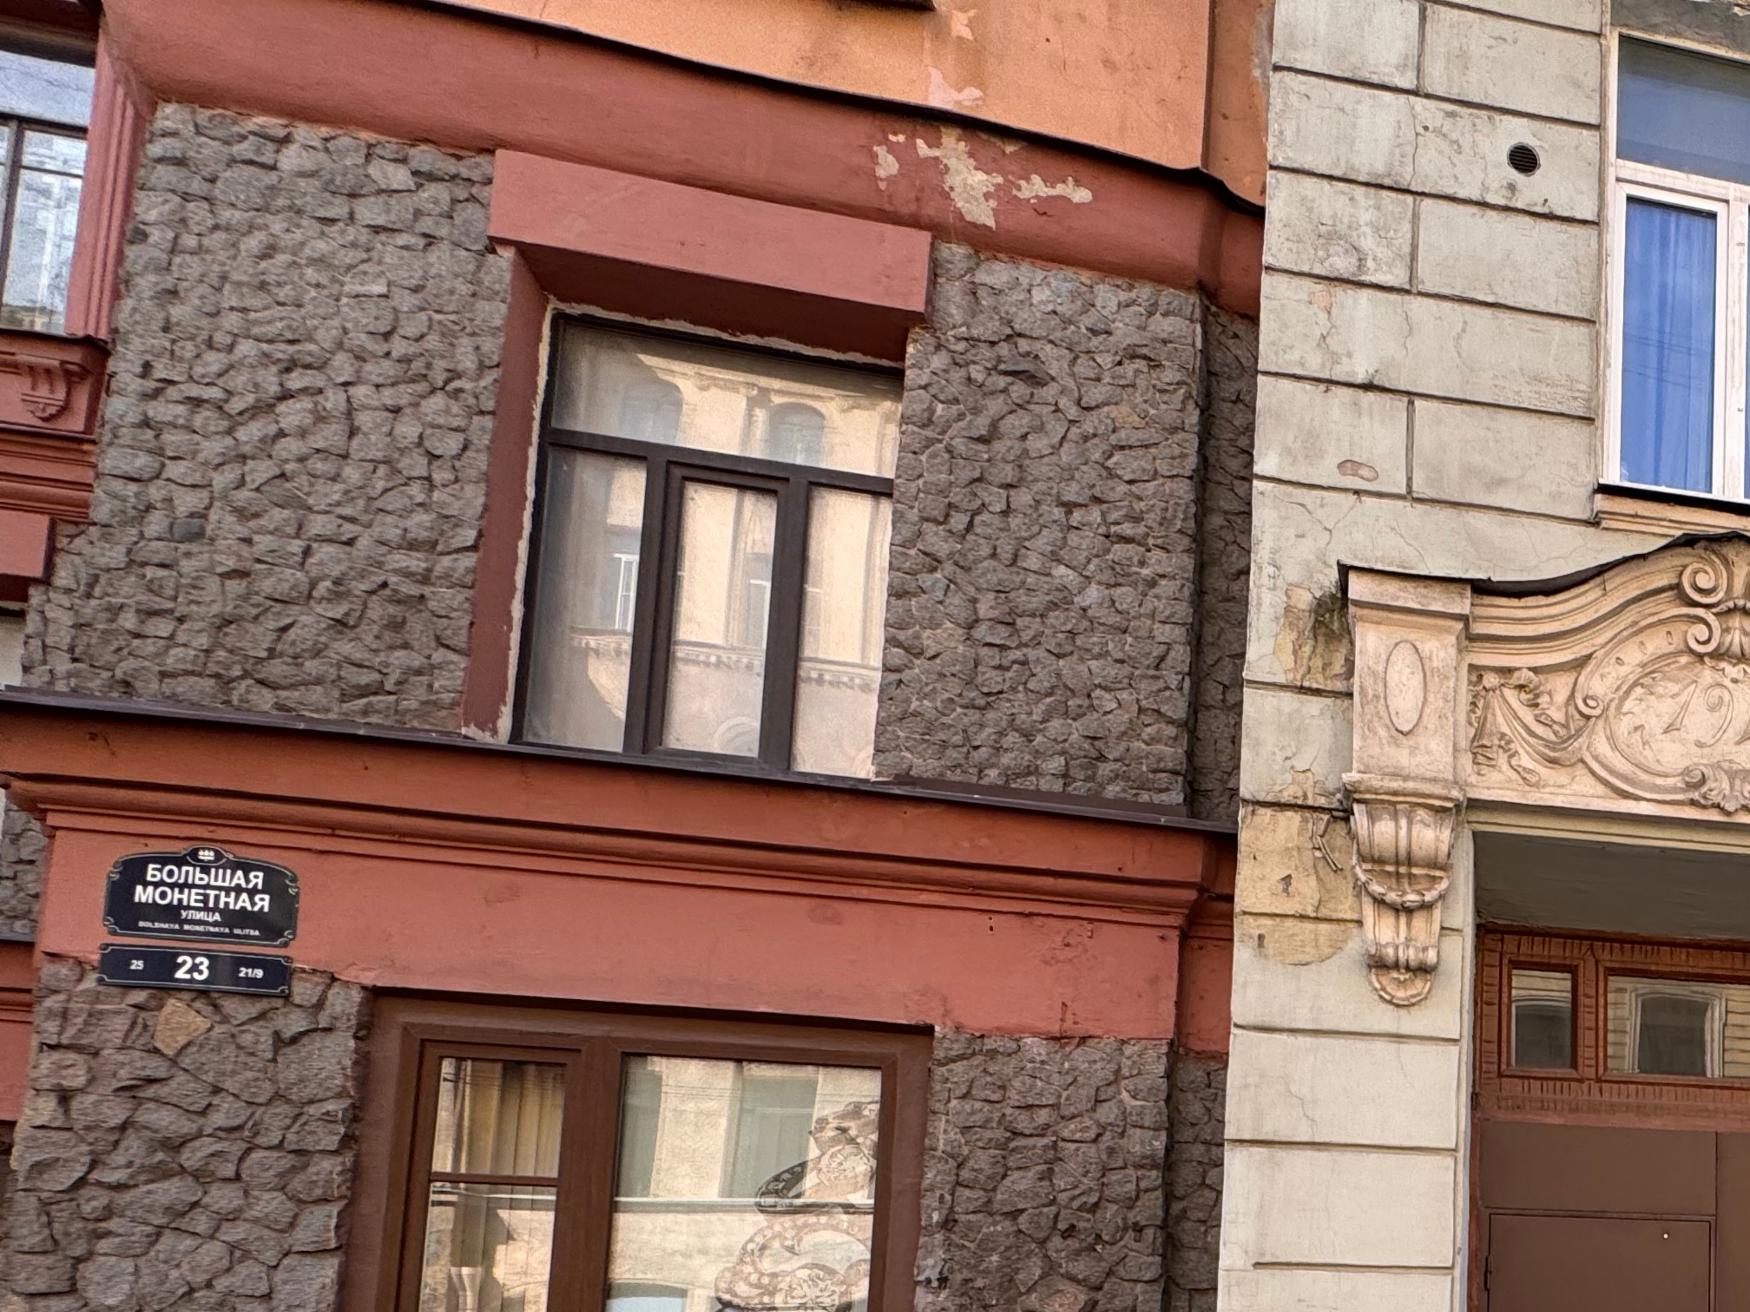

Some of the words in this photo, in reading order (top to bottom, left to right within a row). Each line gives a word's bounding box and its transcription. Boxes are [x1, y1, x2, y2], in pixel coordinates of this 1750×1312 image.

[146, 864, 264, 890] БОЛЬШАЯ
[134, 885, 271, 913] МОНЕТНАЯ
[180, 909, 222, 923] УЛИЦА
[129, 960, 144, 970] 25
[174, 955, 210, 981] 23
[238, 967, 264, 979] 21/9
